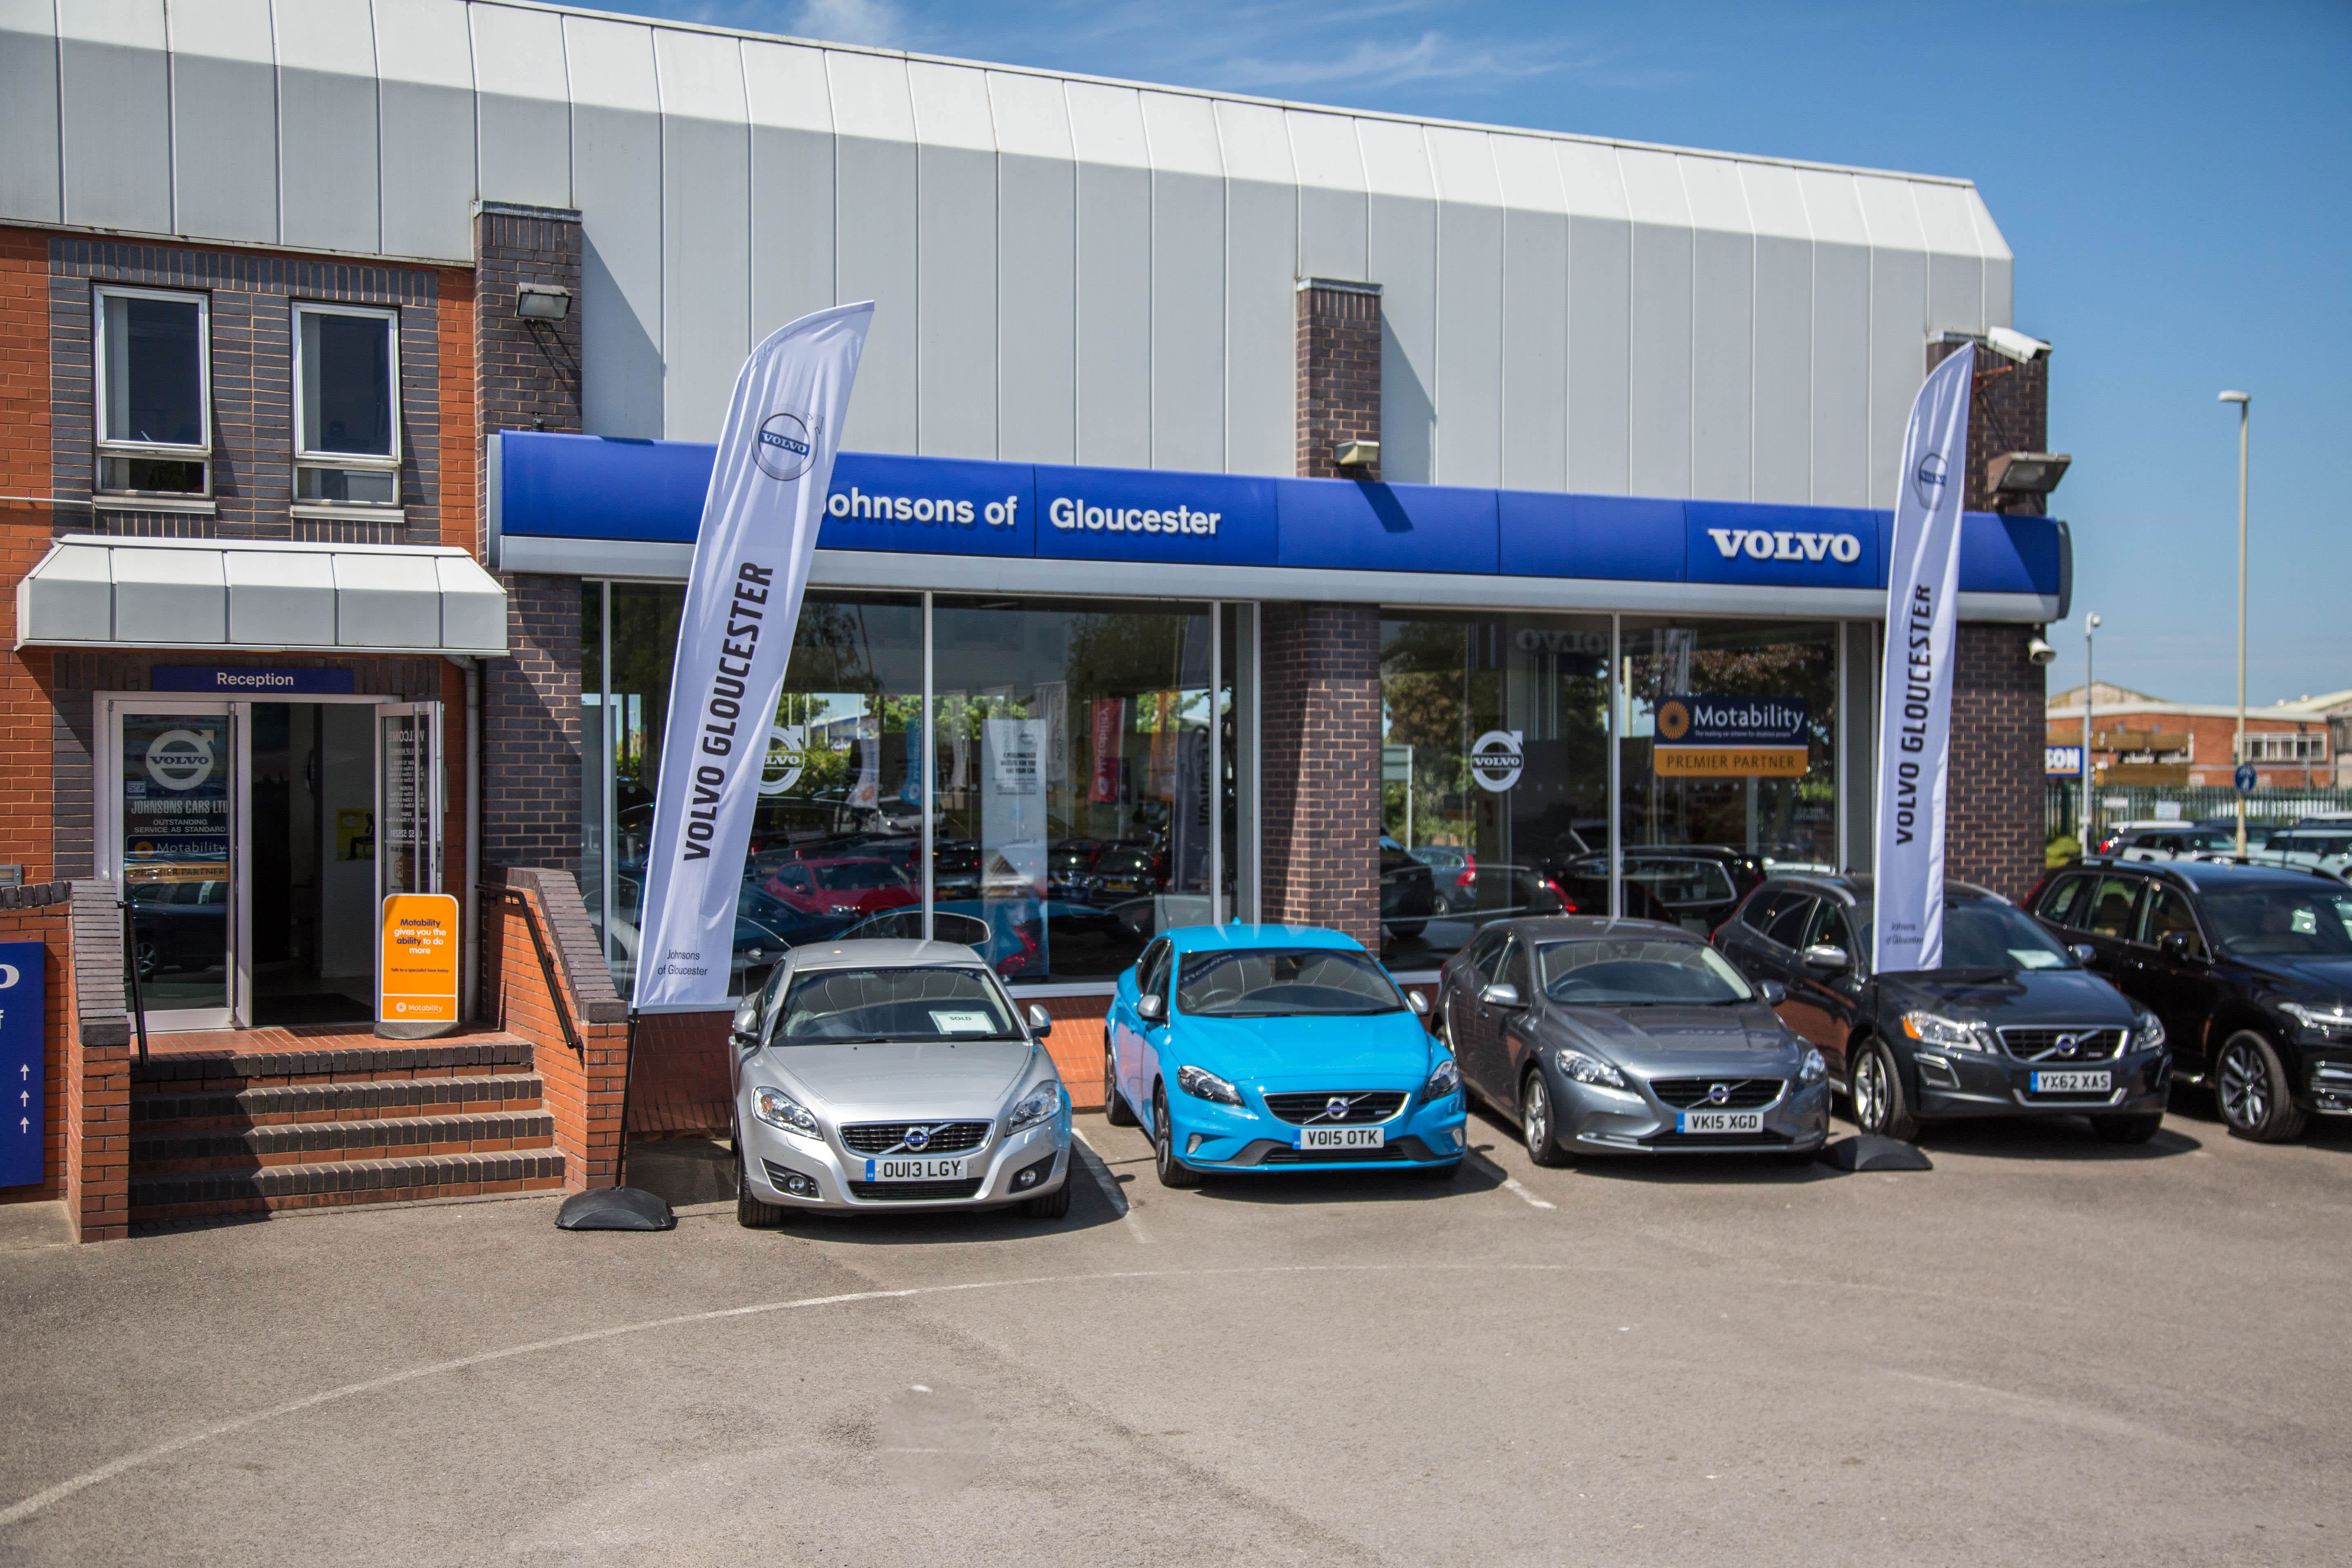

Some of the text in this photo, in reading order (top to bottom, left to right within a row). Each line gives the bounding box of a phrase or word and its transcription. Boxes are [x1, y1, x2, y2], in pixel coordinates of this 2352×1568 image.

[762, 432, 807, 453] VOLVO
[823, 487, 1221, 535] ohnsons of Gloucester
[1707, 528, 1861, 563] VOLVO
[217, 672, 294, 688] Reception
[684, 562, 773, 861] VOLVO GLOUCESTER
[1897, 585, 1931, 845] VOLVO GLOUCESTER
[1694, 703, 1804, 734] Motability
[149, 756, 209, 764] VOLVO
[765, 755, 800, 765] LVO
[1474, 757, 1520, 766] VOLVO
[1666, 755, 1795, 768] PREMIER PARTNER
[131, 800, 228, 814] JOHNSONS CARS LTD
[157, 842, 227, 854] Motability
[134, 867, 224, 877] PREMIER PARTNER
[400, 919, 441, 928] Motability
[394, 928, 415, 937] gives
[397, 937, 421, 946] ability
[667, 949, 700, 960] Johnsons
[657, 964, 708, 976] of Gloucester
[408, 1004, 442, 1013] Motability
[2042, 1075, 2108, 1088] YX62 XAS
[1692, 1115, 1757, 1129] VK15 XGD
[1308, 1130, 1377, 1145] VO15 OTK
[884, 1160, 961, 1178] OU13 LGY
